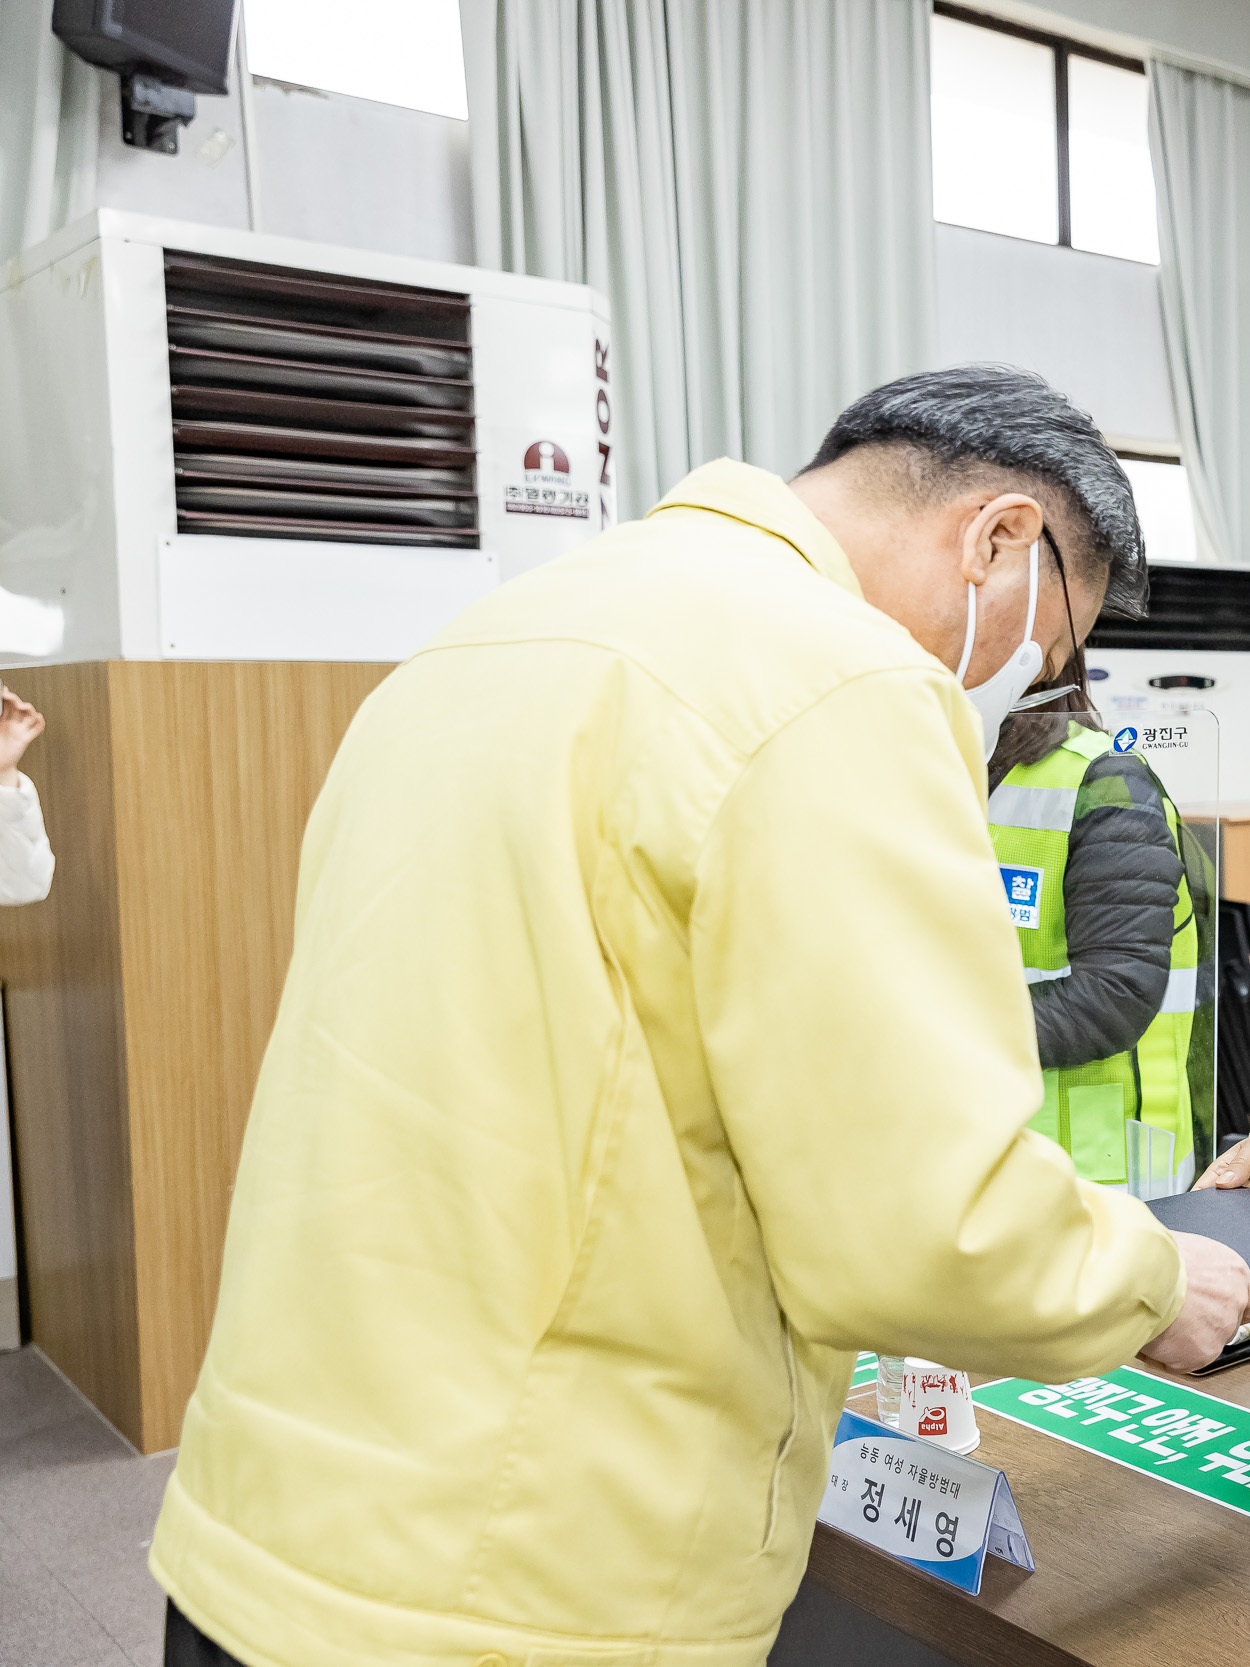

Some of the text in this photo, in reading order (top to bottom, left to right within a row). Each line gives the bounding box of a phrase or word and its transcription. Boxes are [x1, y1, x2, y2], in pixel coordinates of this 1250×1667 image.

[1142, 726, 1188, 742] 광진구
[1142, 740, 1189, 750] GWANGJIN-GU
[921, 1422, 945, 1431] Alpha
[860, 1442, 962, 1500] 능동 여성 자율방범대
